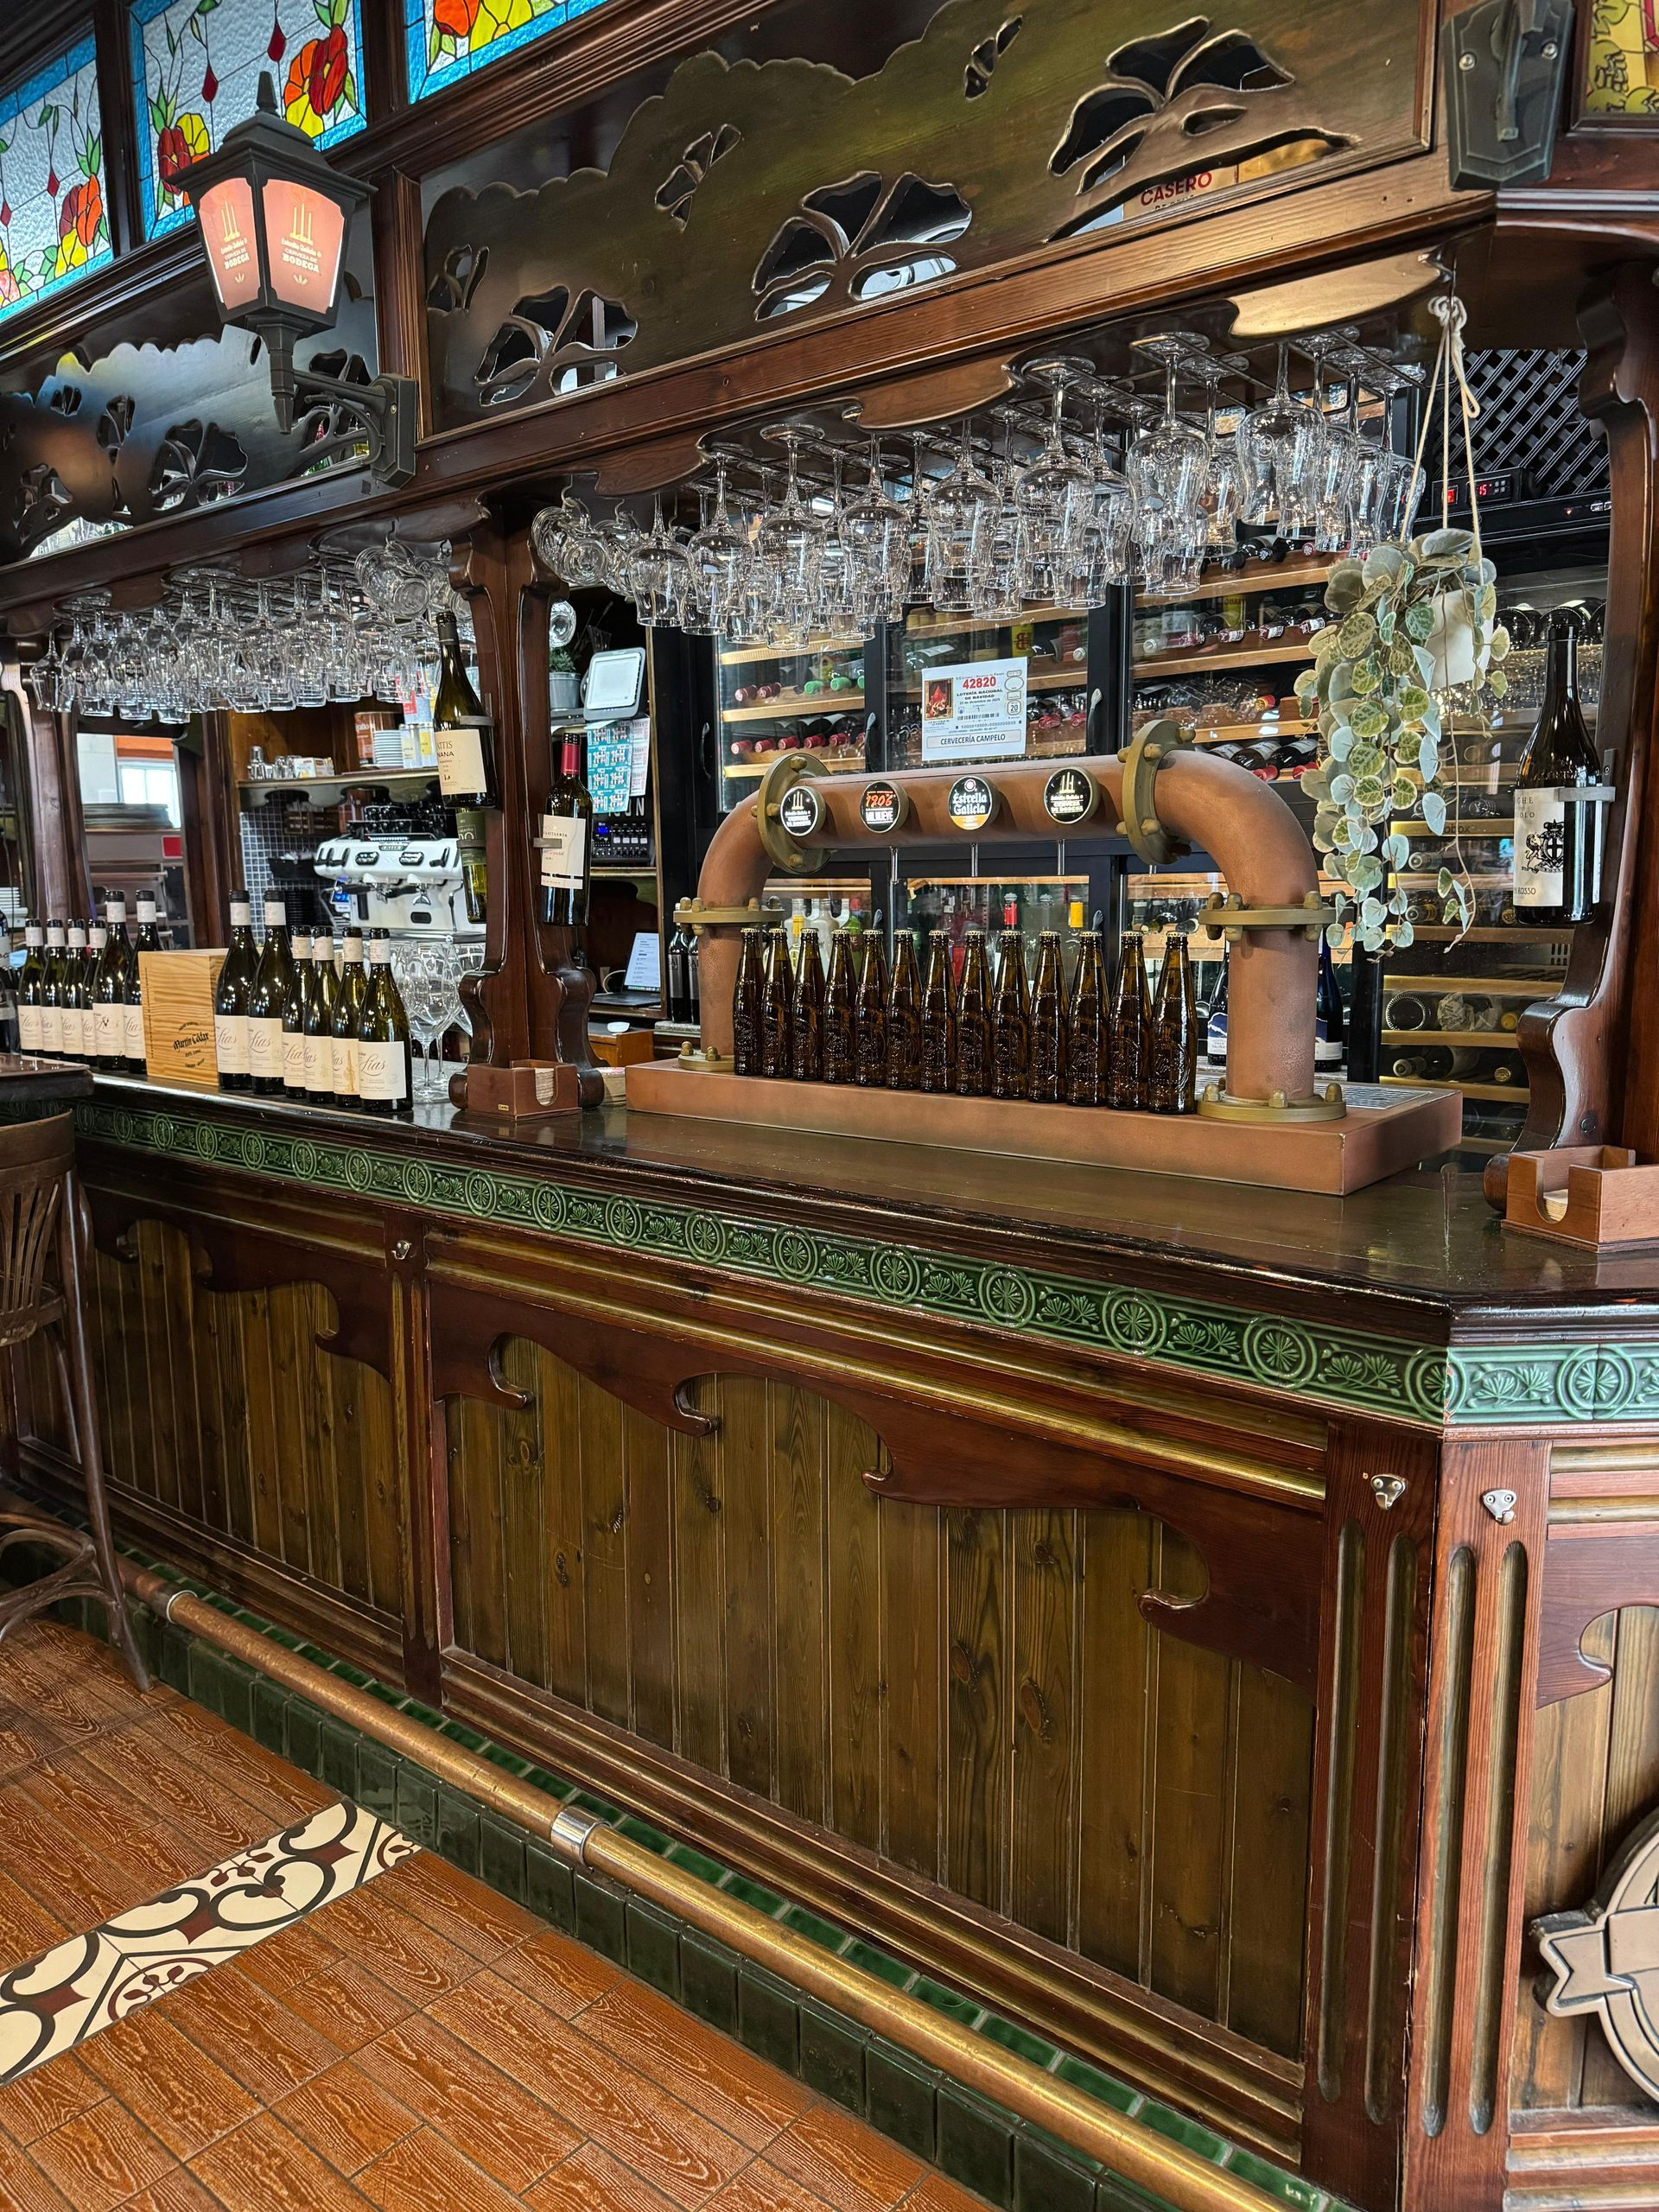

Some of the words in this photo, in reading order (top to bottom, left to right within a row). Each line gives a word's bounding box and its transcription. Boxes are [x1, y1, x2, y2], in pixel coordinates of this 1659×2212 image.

[1141, 172, 1212, 206] CASERO
[224, 252, 250, 270] BODEGA
[283, 252, 320, 273] BODEGA
[963, 676, 997, 690] 42820
[940, 735, 976, 745] CERVECERÍA
[976, 734, 1006, 743] CAMPELO
[951, 790, 988, 804] Estrella
[953, 803, 986, 816] Galicia
[217, 1027, 237, 1051] Lias
[249, 1030, 270, 1054] Lias
[359, 1053, 387, 1077] Lias
